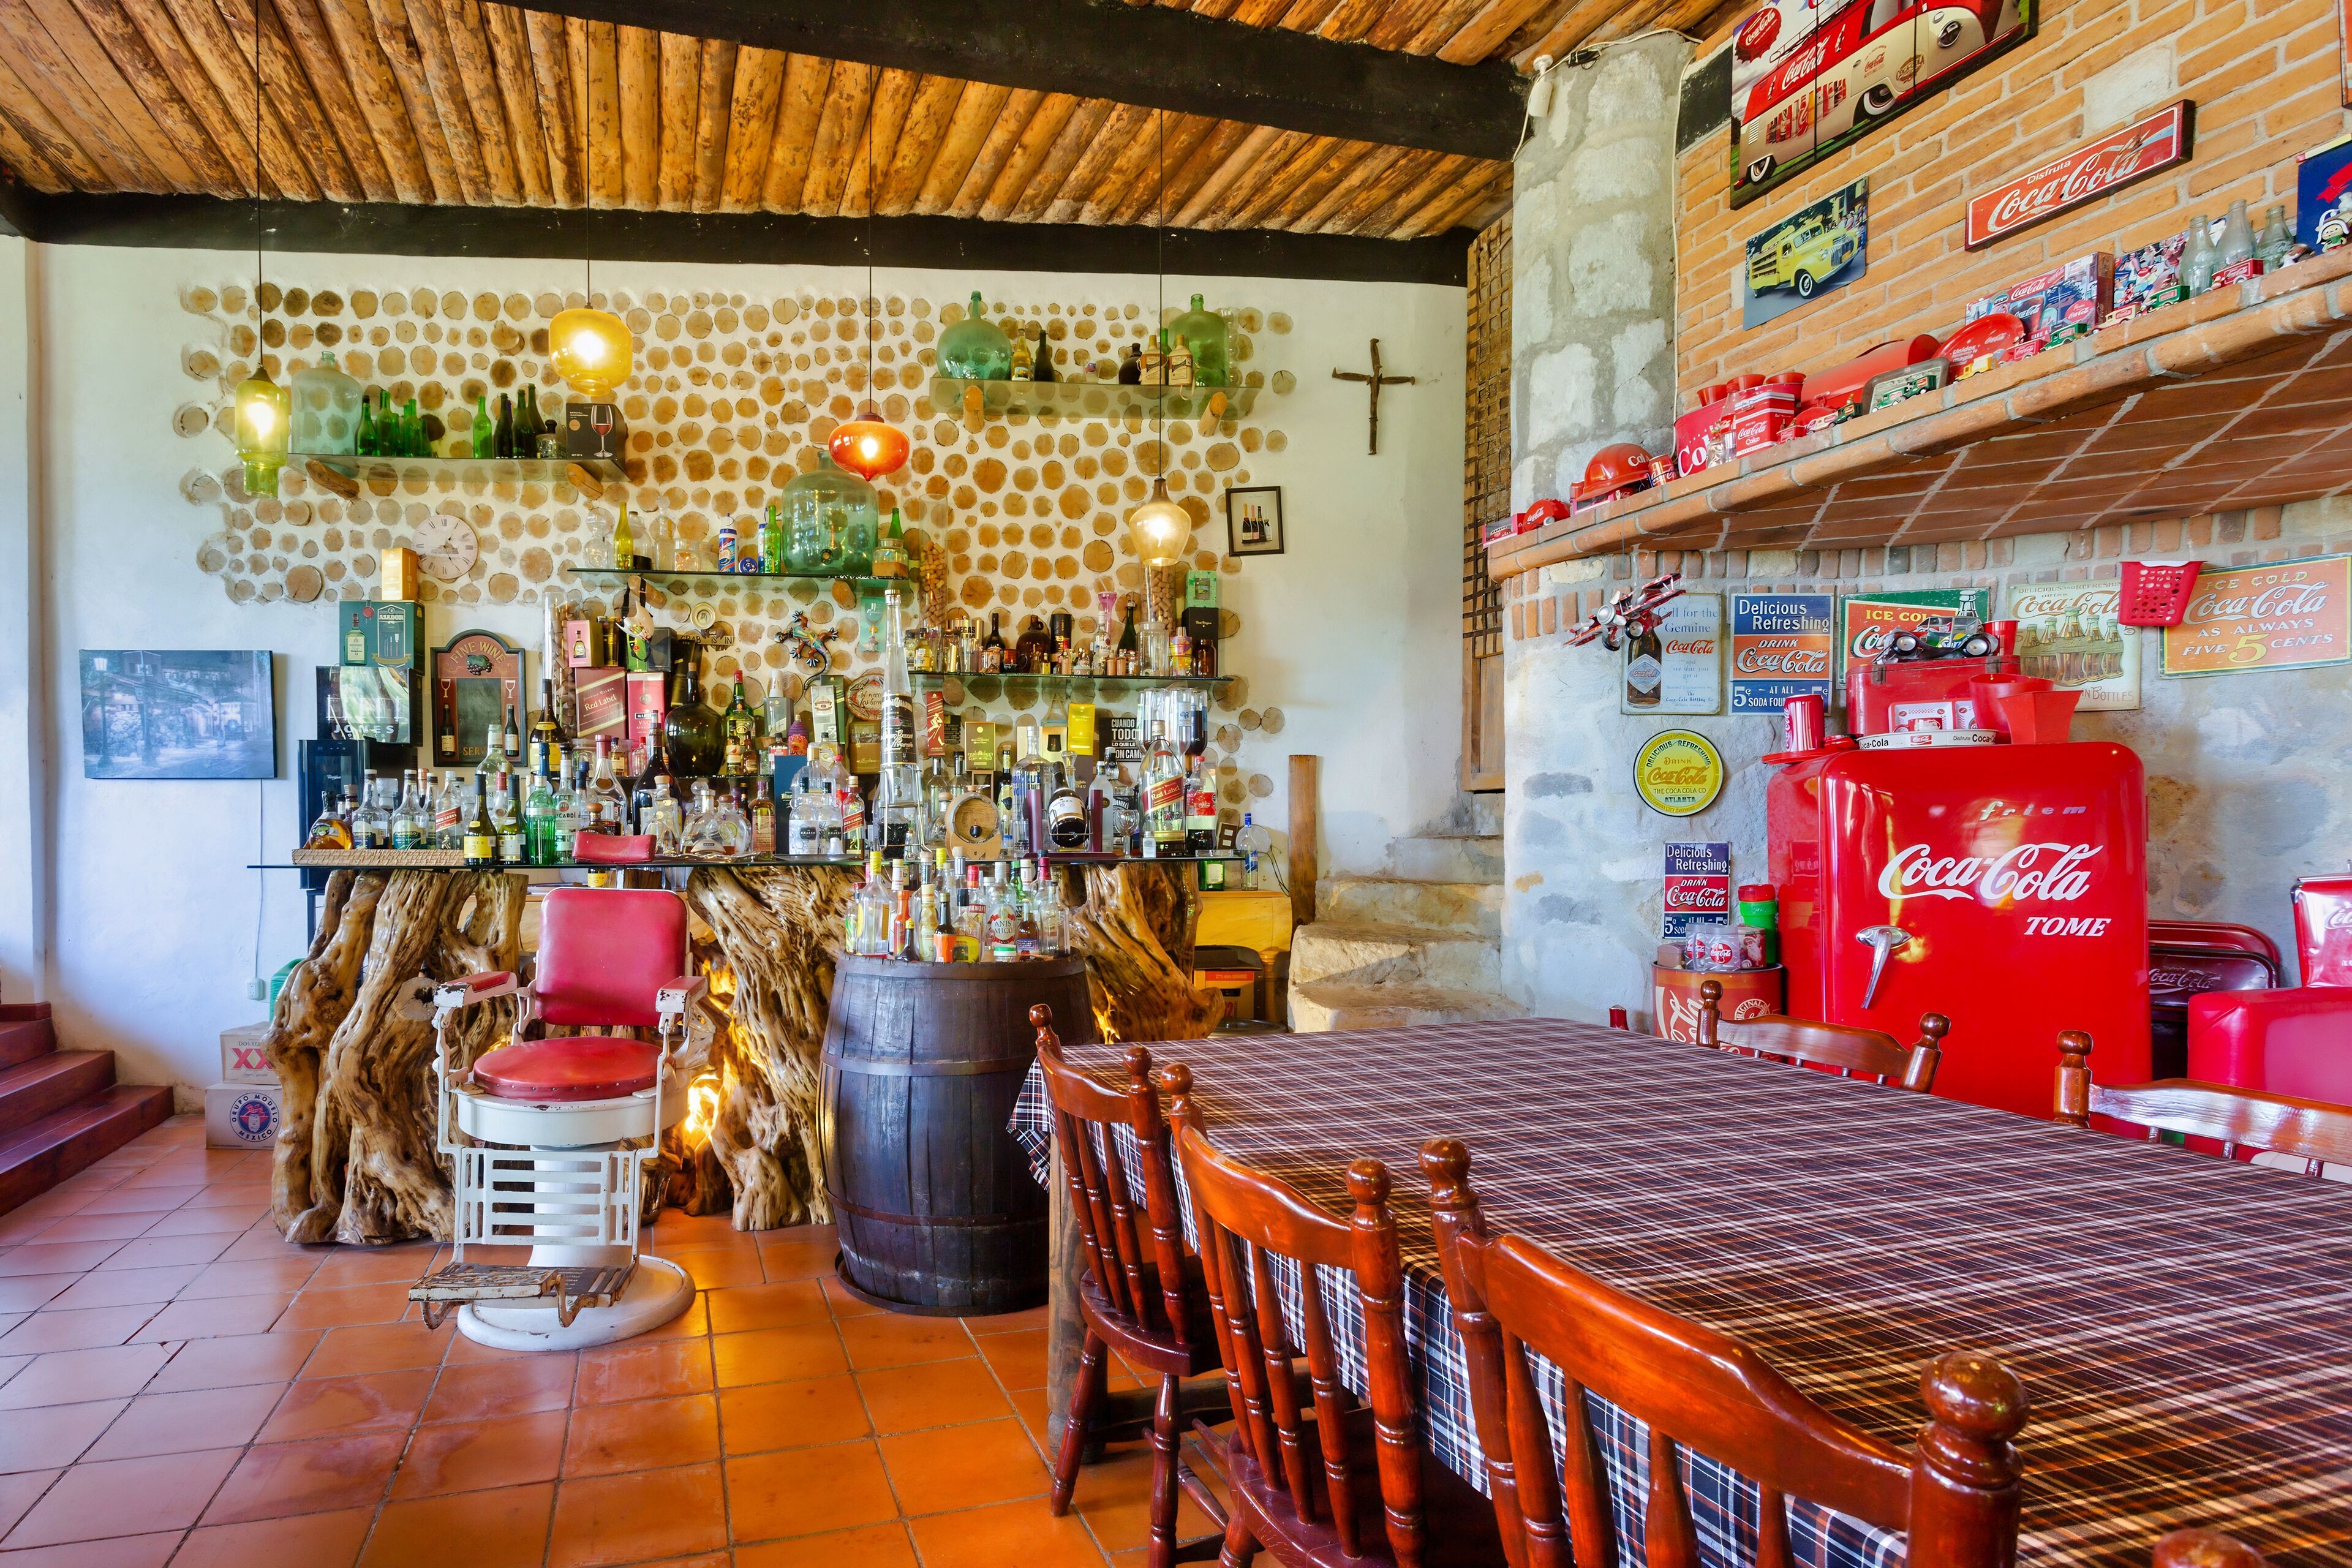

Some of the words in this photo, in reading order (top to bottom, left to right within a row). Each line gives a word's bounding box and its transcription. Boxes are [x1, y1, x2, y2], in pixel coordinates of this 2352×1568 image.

[1746, 8, 1776, 46] Coca-Cola
[1782, 35, 1831, 91] Coca-Cola
[1987, 129, 2152, 232] Coca-Cola
[2026, 158, 2071, 186] Disfruta
[1738, 420, 1768, 440] Coca-Cola
[1677, 434, 1709, 478] Col
[2075, 581, 2122, 590] REFRESHIN
[2204, 578, 2241, 590] ICE
[2250, 571, 2309, 587] COLD
[1738, 598, 1808, 616] Delicious
[2182, 581, 2331, 625] Coca-Cola
[1657, 607, 1678, 618] Cll
[1683, 607, 1698, 617] for
[1702, 607, 1718, 618] the
[1866, 609, 1894, 620] ICE
[1898, 612, 1929, 622] COL
[1665, 622, 1711, 633] Genuine
[1752, 615, 1830, 633] Refreshing
[2196, 627, 2222, 638] AS
[2232, 618, 2315, 635] ALWAYS
[450, 641, 476, 663] FINE
[479, 641, 505, 663] WINE
[1665, 639, 1716, 655] Coca-Cola
[1757, 638, 1799, 649] DRINK
[2182, 643, 2230, 657] FIVE
[2227, 633, 2270, 663] 5
[2270, 633, 2334, 649] CENTS
[1736, 646, 1830, 674] Coca-Cola
[1769, 685, 1779, 695] AT
[1781, 685, 1794, 695] ALL
[2090, 685, 2135, 702] BOTTLES
[584, 701, 597, 711] Red
[598, 694, 617, 706] Label
[1748, 697, 1768, 707] SODA
[1111, 718, 1135, 728] CUANDO
[462, 747, 486, 756] SERV
[1115, 749, 1125, 759] ON
[1646, 741, 1672, 768] DELICIOUS
[1678, 739, 1711, 766] REFRESHING
[1646, 766, 1710, 786] Coca-Cola
[1152, 791, 1164, 801] Red
[1164, 785, 1181, 796] Label
[1667, 845, 1713, 858] Delicious
[1676, 859, 1727, 873] Refreshing
[1877, 843, 2105, 902] Coca-Cola
[1680, 878, 1708, 888] DRINK
[1667, 885, 1727, 908] Coca-Cola
[2023, 916, 2113, 937] TOME
[231, 1047, 273, 1069] XX
[254, 1094, 277, 1123] MODELO
[238, 1129, 273, 1140] MEXICO
